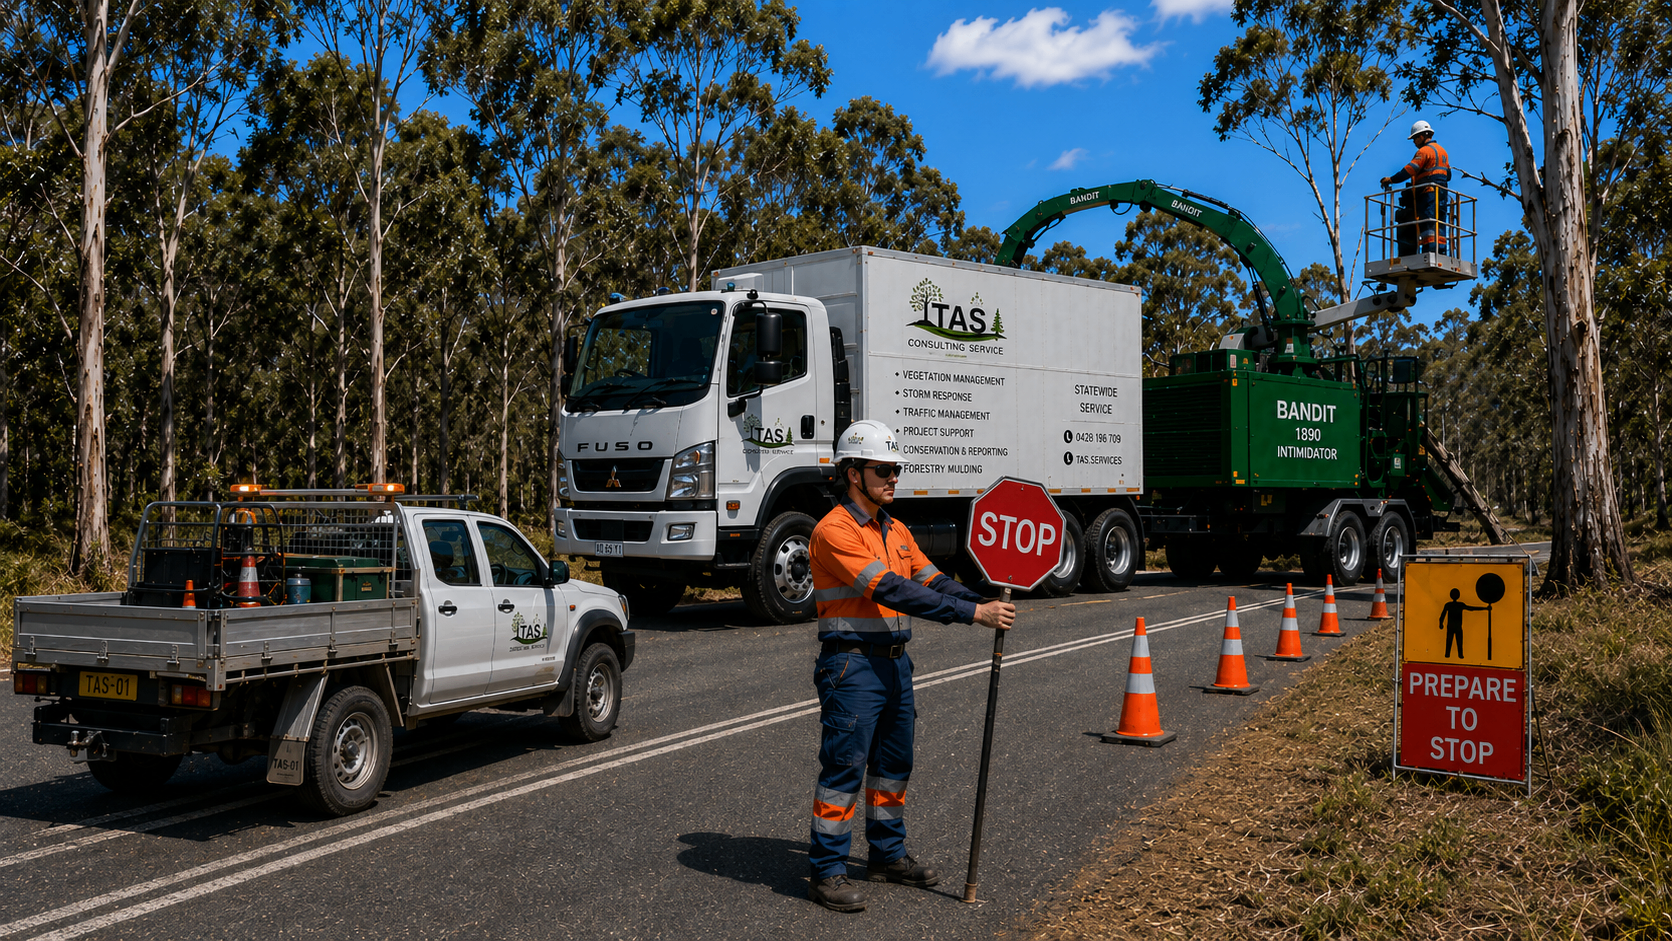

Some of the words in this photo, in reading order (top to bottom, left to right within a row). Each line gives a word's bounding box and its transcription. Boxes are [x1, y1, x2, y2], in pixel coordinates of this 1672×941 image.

[1070, 191, 1100, 205] BANDIT
[1171, 199, 1202, 218] BANDIT
[931, 302, 987, 334] TAS
[907, 338, 966, 352] CONSULTING
[969, 344, 1004, 356] SERVICE
[903, 370, 951, 382] VEGETATION
[953, 374, 1005, 386] MANAGEMENT
[903, 388, 931, 399] STORM
[932, 390, 972, 402] RESPONSE
[1074, 384, 1118, 398] STATEWIDE
[903, 407, 936, 418] TRAFFIC
[938, 409, 990, 421] MANAGEMENT
[1080, 402, 1113, 415] SERVICE
[1276, 400, 1337, 423] BANDIT
[754, 427, 784, 443] TAS
[903, 426, 938, 437] PROJECT
[940, 428, 974, 438] SUPPORT
[1076, 432, 1094, 443] 0428
[1095, 433, 1107, 443] 196
[1108, 434, 1121, 444] 709
[1295, 427, 1321, 442] 1890
[577, 441, 653, 452] FUSO
[903, 445, 960, 456] CONSERVATION
[961, 446, 967, 456] &
[968, 447, 1008, 457] REPORTING
[1277, 445, 1338, 460] INTIMIDATOR
[1076, 455, 1122, 465] TAS.SERVICES
[903, 464, 946, 474] FORESTRY
[947, 464, 983, 474] MULDING
[978, 511, 1057, 557] STOP
[520, 624, 541, 639] TAS
[86, 675, 130, 697] TAS-01
[1409, 672, 1517, 703] PREPARE
[1446, 705, 1478, 731] TO
[1430, 736, 1494, 765] STOP
[274, 758, 299, 771] TAS-01
